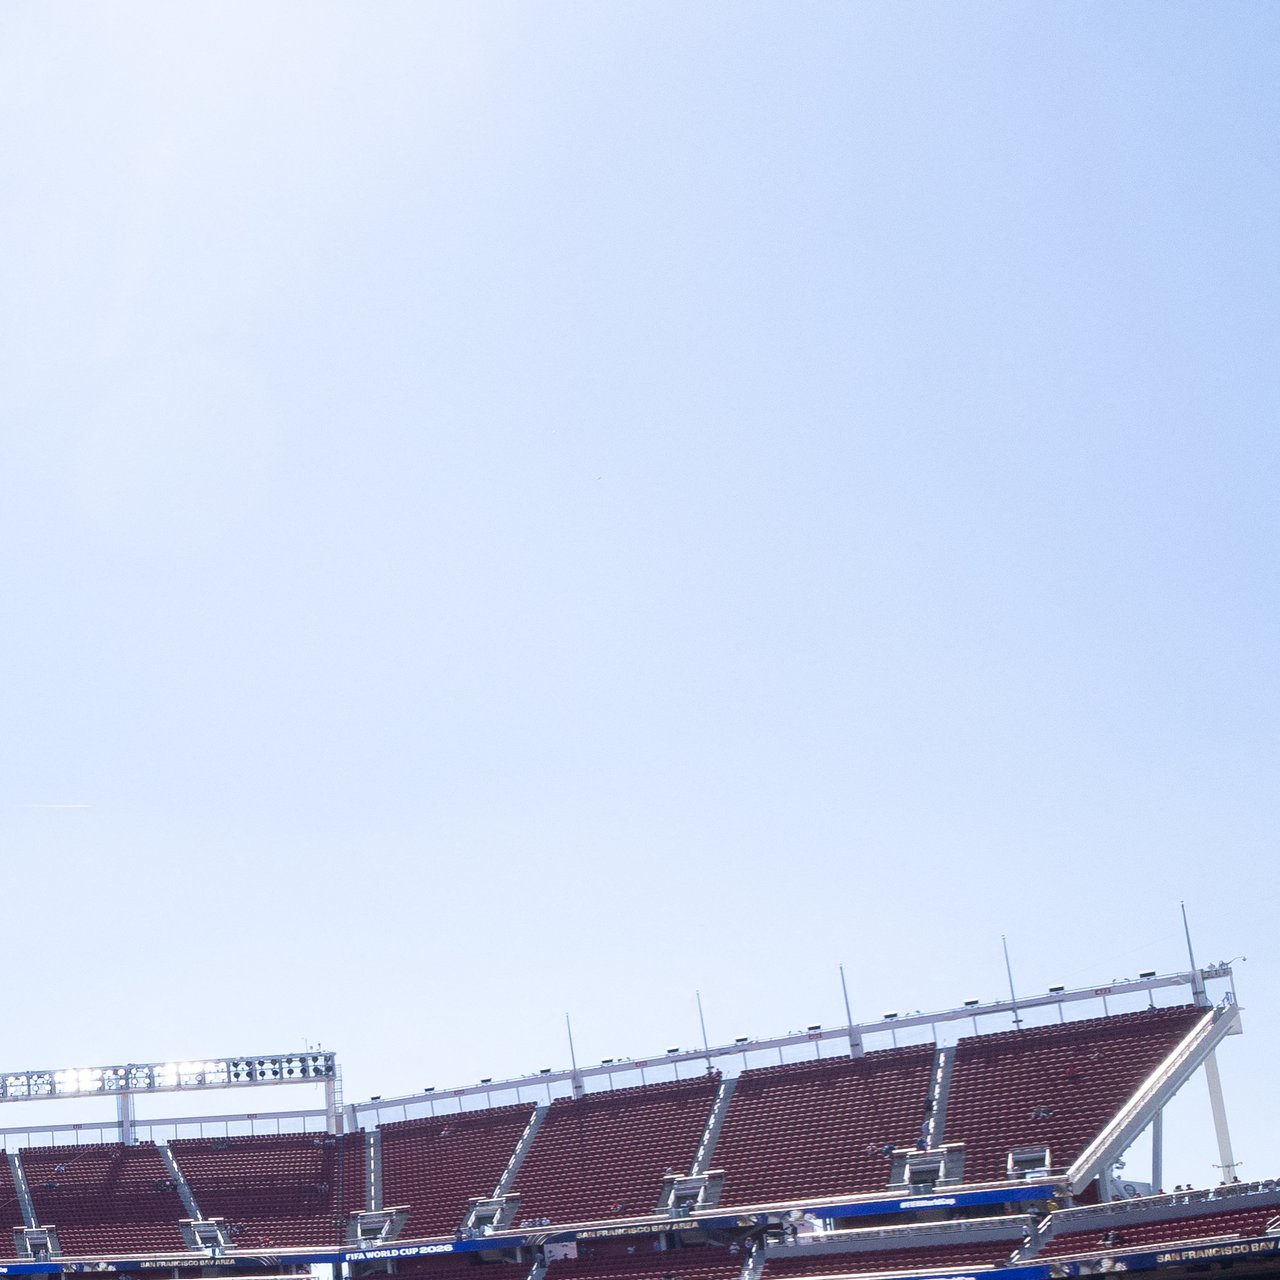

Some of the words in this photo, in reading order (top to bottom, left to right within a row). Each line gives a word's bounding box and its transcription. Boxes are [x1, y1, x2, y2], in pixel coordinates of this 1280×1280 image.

[346, 1252, 365, 1260] FIFA
[366, 1248, 399, 1259] WORLD
[400, 1246, 419, 1256] CUP
[420, 1243, 453, 1254] 2026
[1157, 1253, 1180, 1262] SAN
[1182, 1246, 1249, 1259] FRANCISCO
[1251, 1242, 1274, 1252] BAY
